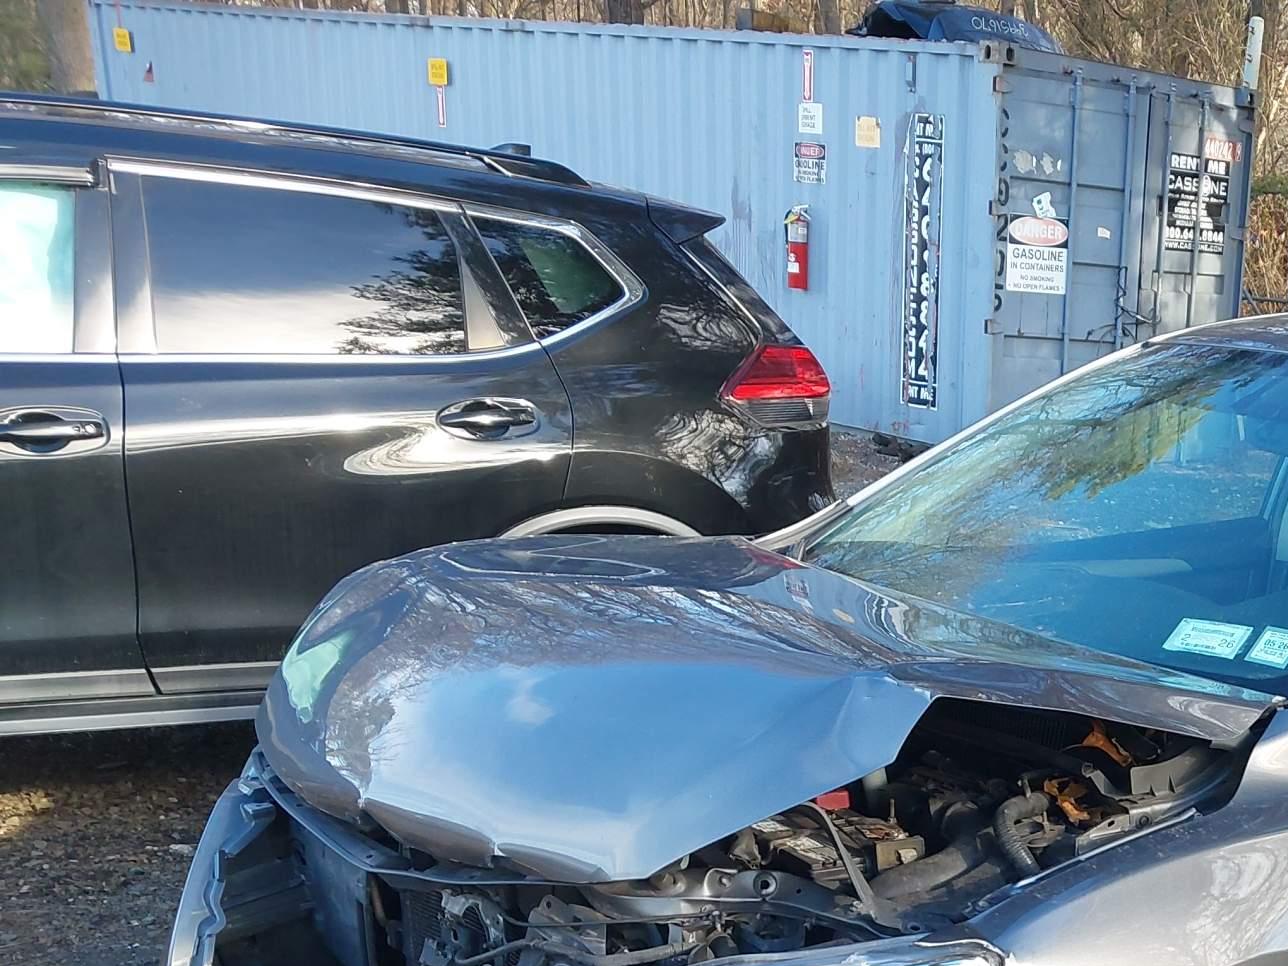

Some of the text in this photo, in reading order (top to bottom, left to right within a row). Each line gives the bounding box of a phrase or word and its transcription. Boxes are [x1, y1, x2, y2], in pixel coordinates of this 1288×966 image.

[1015, 222, 1062, 240] DANGER
[1012, 247, 1064, 262] GASOLINE
[1019, 262, 1064, 273] CONTAINERS
